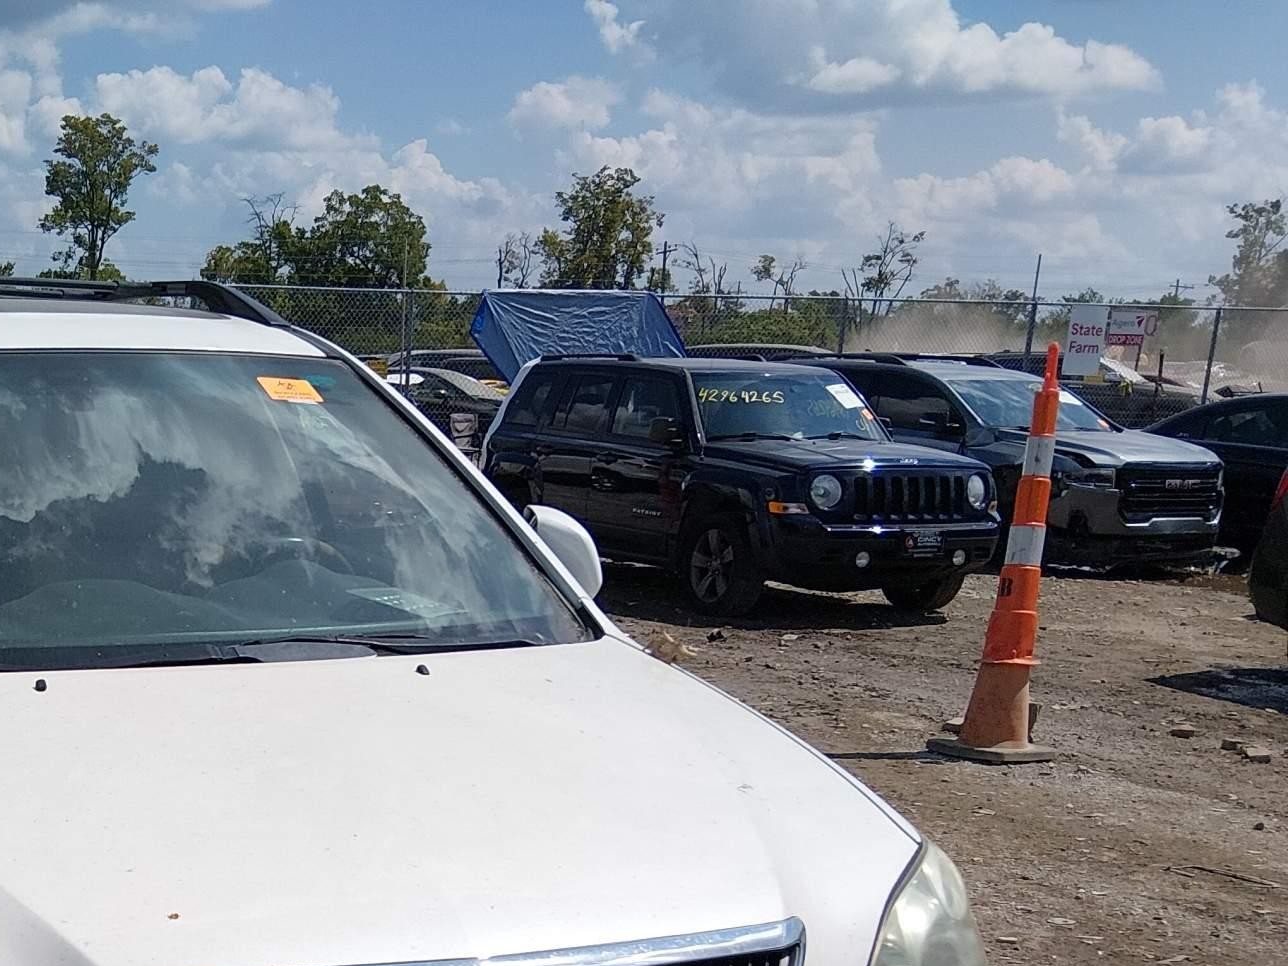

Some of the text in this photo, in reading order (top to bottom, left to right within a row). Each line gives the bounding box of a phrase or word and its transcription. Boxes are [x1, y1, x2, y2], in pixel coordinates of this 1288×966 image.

[1071, 323, 1103, 337] State
[1109, 336, 1143, 345] DROP ZONE
[1068, 341, 1099, 354] Farm
[698, 387, 785, 404] 42964265
